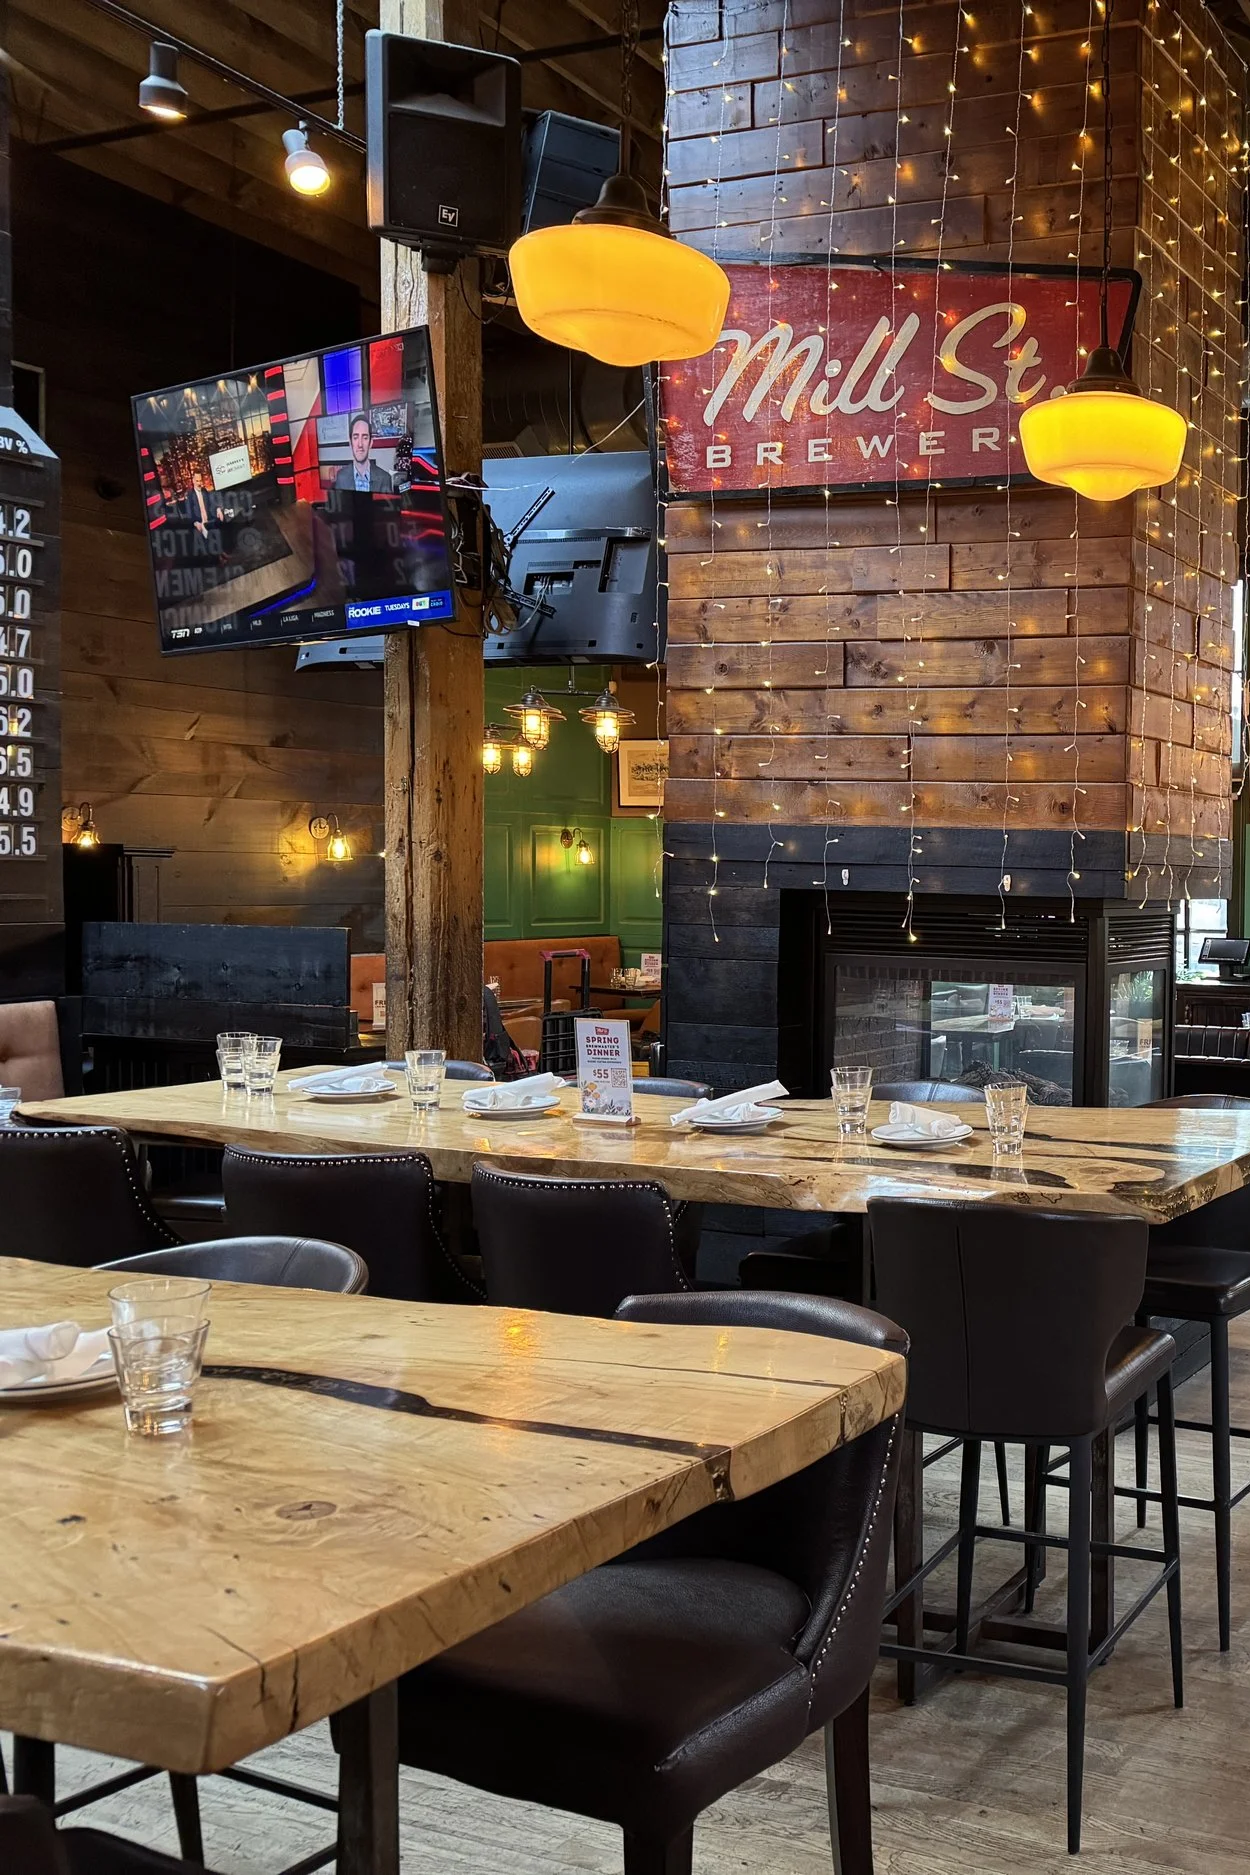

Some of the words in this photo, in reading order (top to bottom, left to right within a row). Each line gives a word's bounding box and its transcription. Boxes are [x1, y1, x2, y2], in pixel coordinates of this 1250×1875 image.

[442, 208, 456, 223] EV
[703, 311, 920, 427] Mill
[706, 426, 1001, 470] BREWER
[348, 606, 382, 618] ROOKIE
[586, 1036, 619, 1045] SPRING
[587, 1048, 621, 1057] DINNER
[592, 1068, 609, 1079] $55
